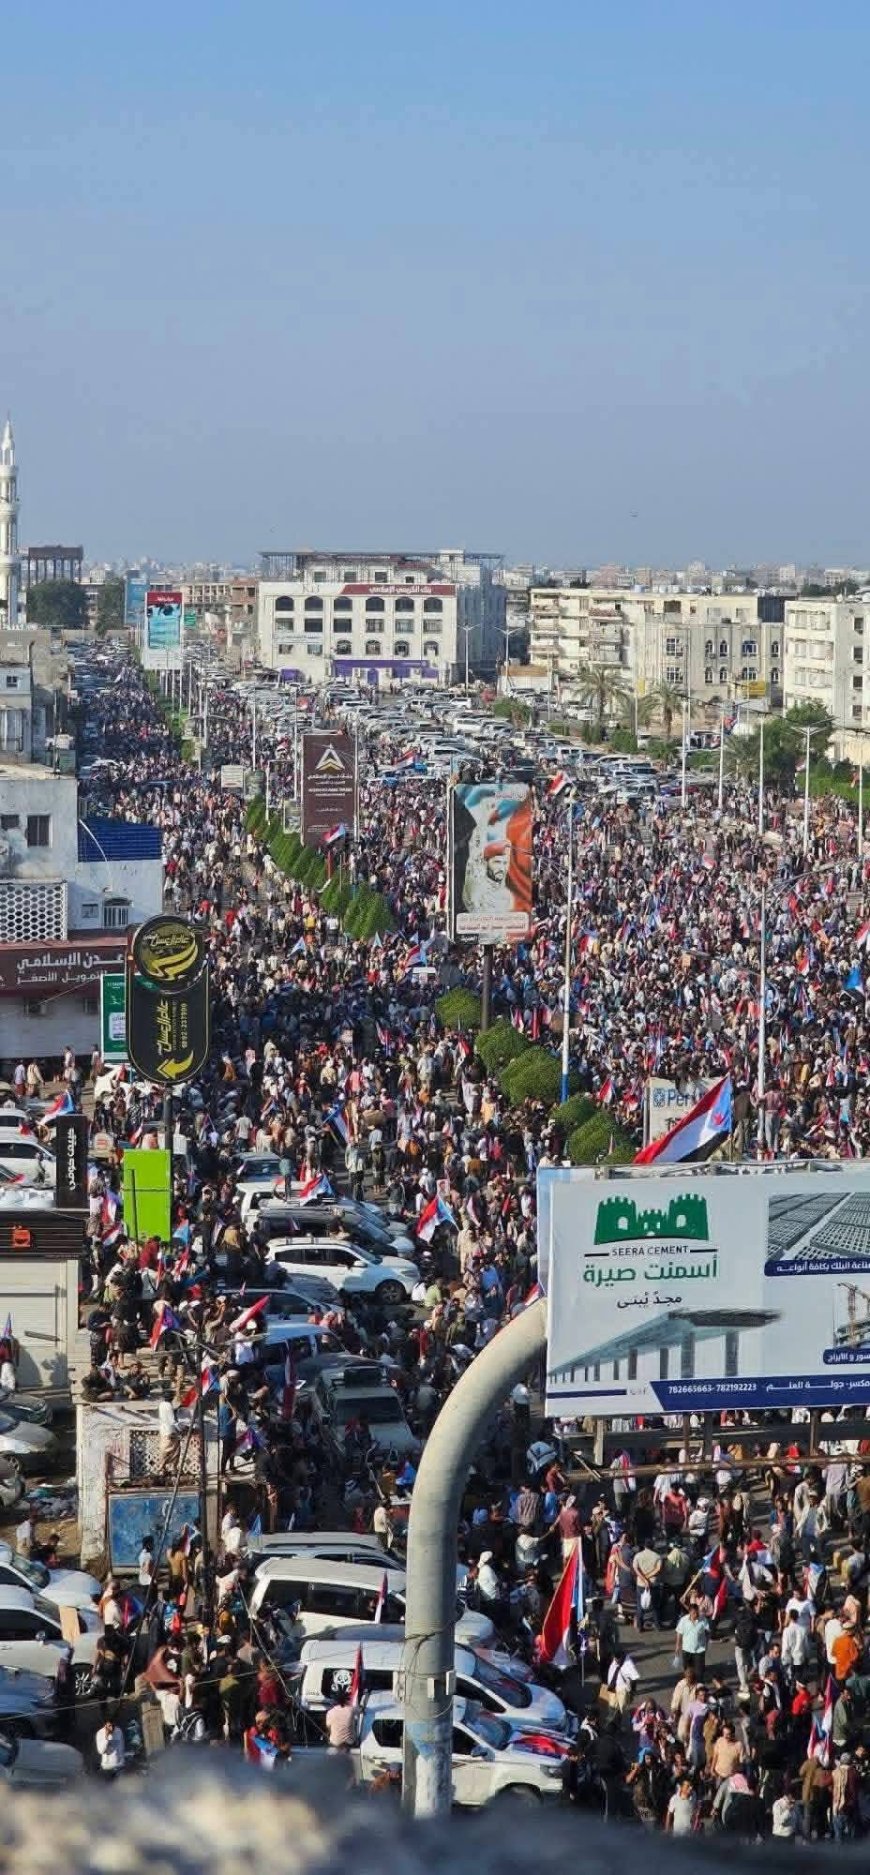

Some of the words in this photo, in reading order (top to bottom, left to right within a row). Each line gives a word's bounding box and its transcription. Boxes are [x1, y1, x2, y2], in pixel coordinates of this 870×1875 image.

[16, 952, 81, 974] الإسلامي
[83, 952, 124, 968] عدن
[612, 1247, 645, 1257] SEERA
[647, 1245, 689, 1256] CEMENT
[644, 1254, 718, 1281] أسمنت
[808, 1262, 830, 1271] بكافة
[583, 1264, 637, 1288] صيرة
[716, 1383, 757, 1393] 782192223
